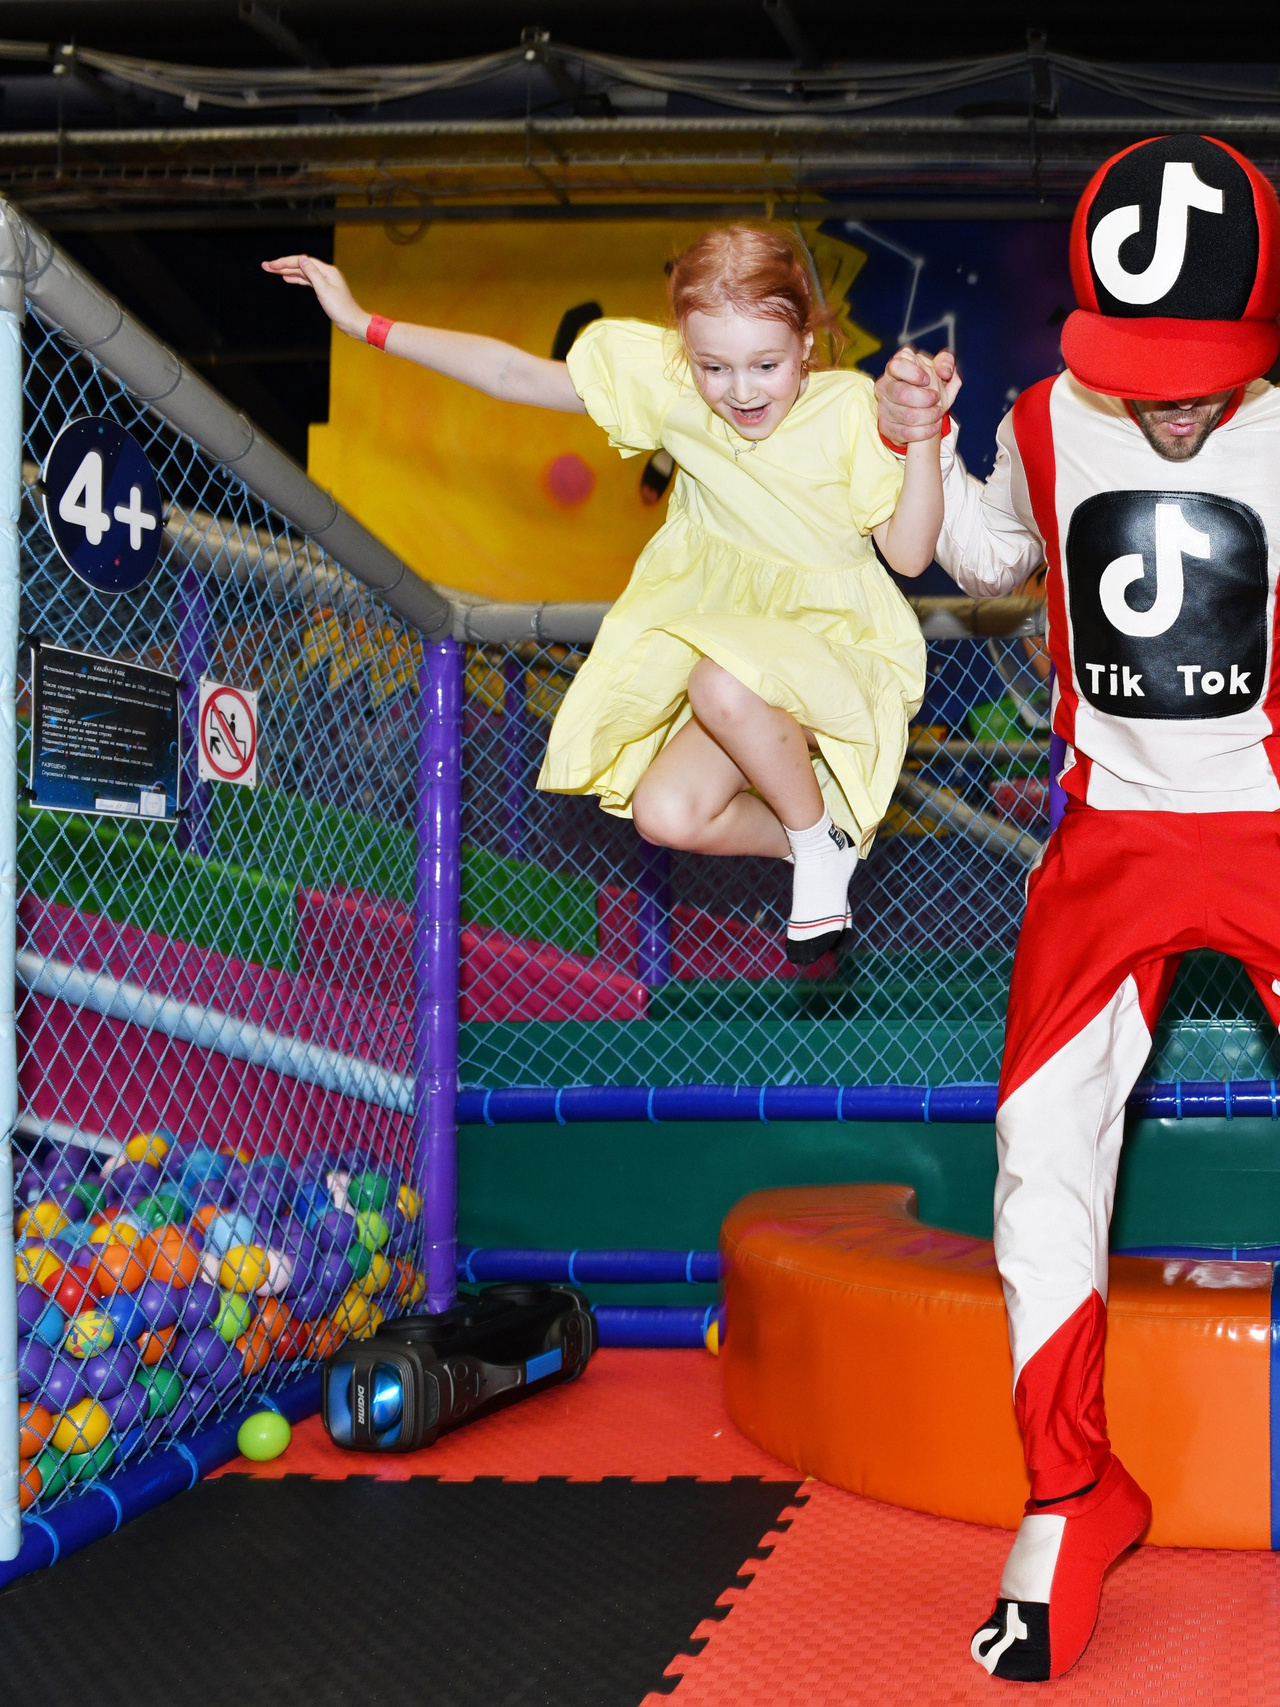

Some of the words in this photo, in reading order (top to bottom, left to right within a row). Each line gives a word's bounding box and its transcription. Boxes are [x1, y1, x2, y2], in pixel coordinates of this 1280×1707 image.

[59, 451, 157, 551] 4+
[1085, 662, 1145, 697] Tik
[1176, 663, 1251, 697] Tok
[357, 1384, 365, 1425] DIGMA
